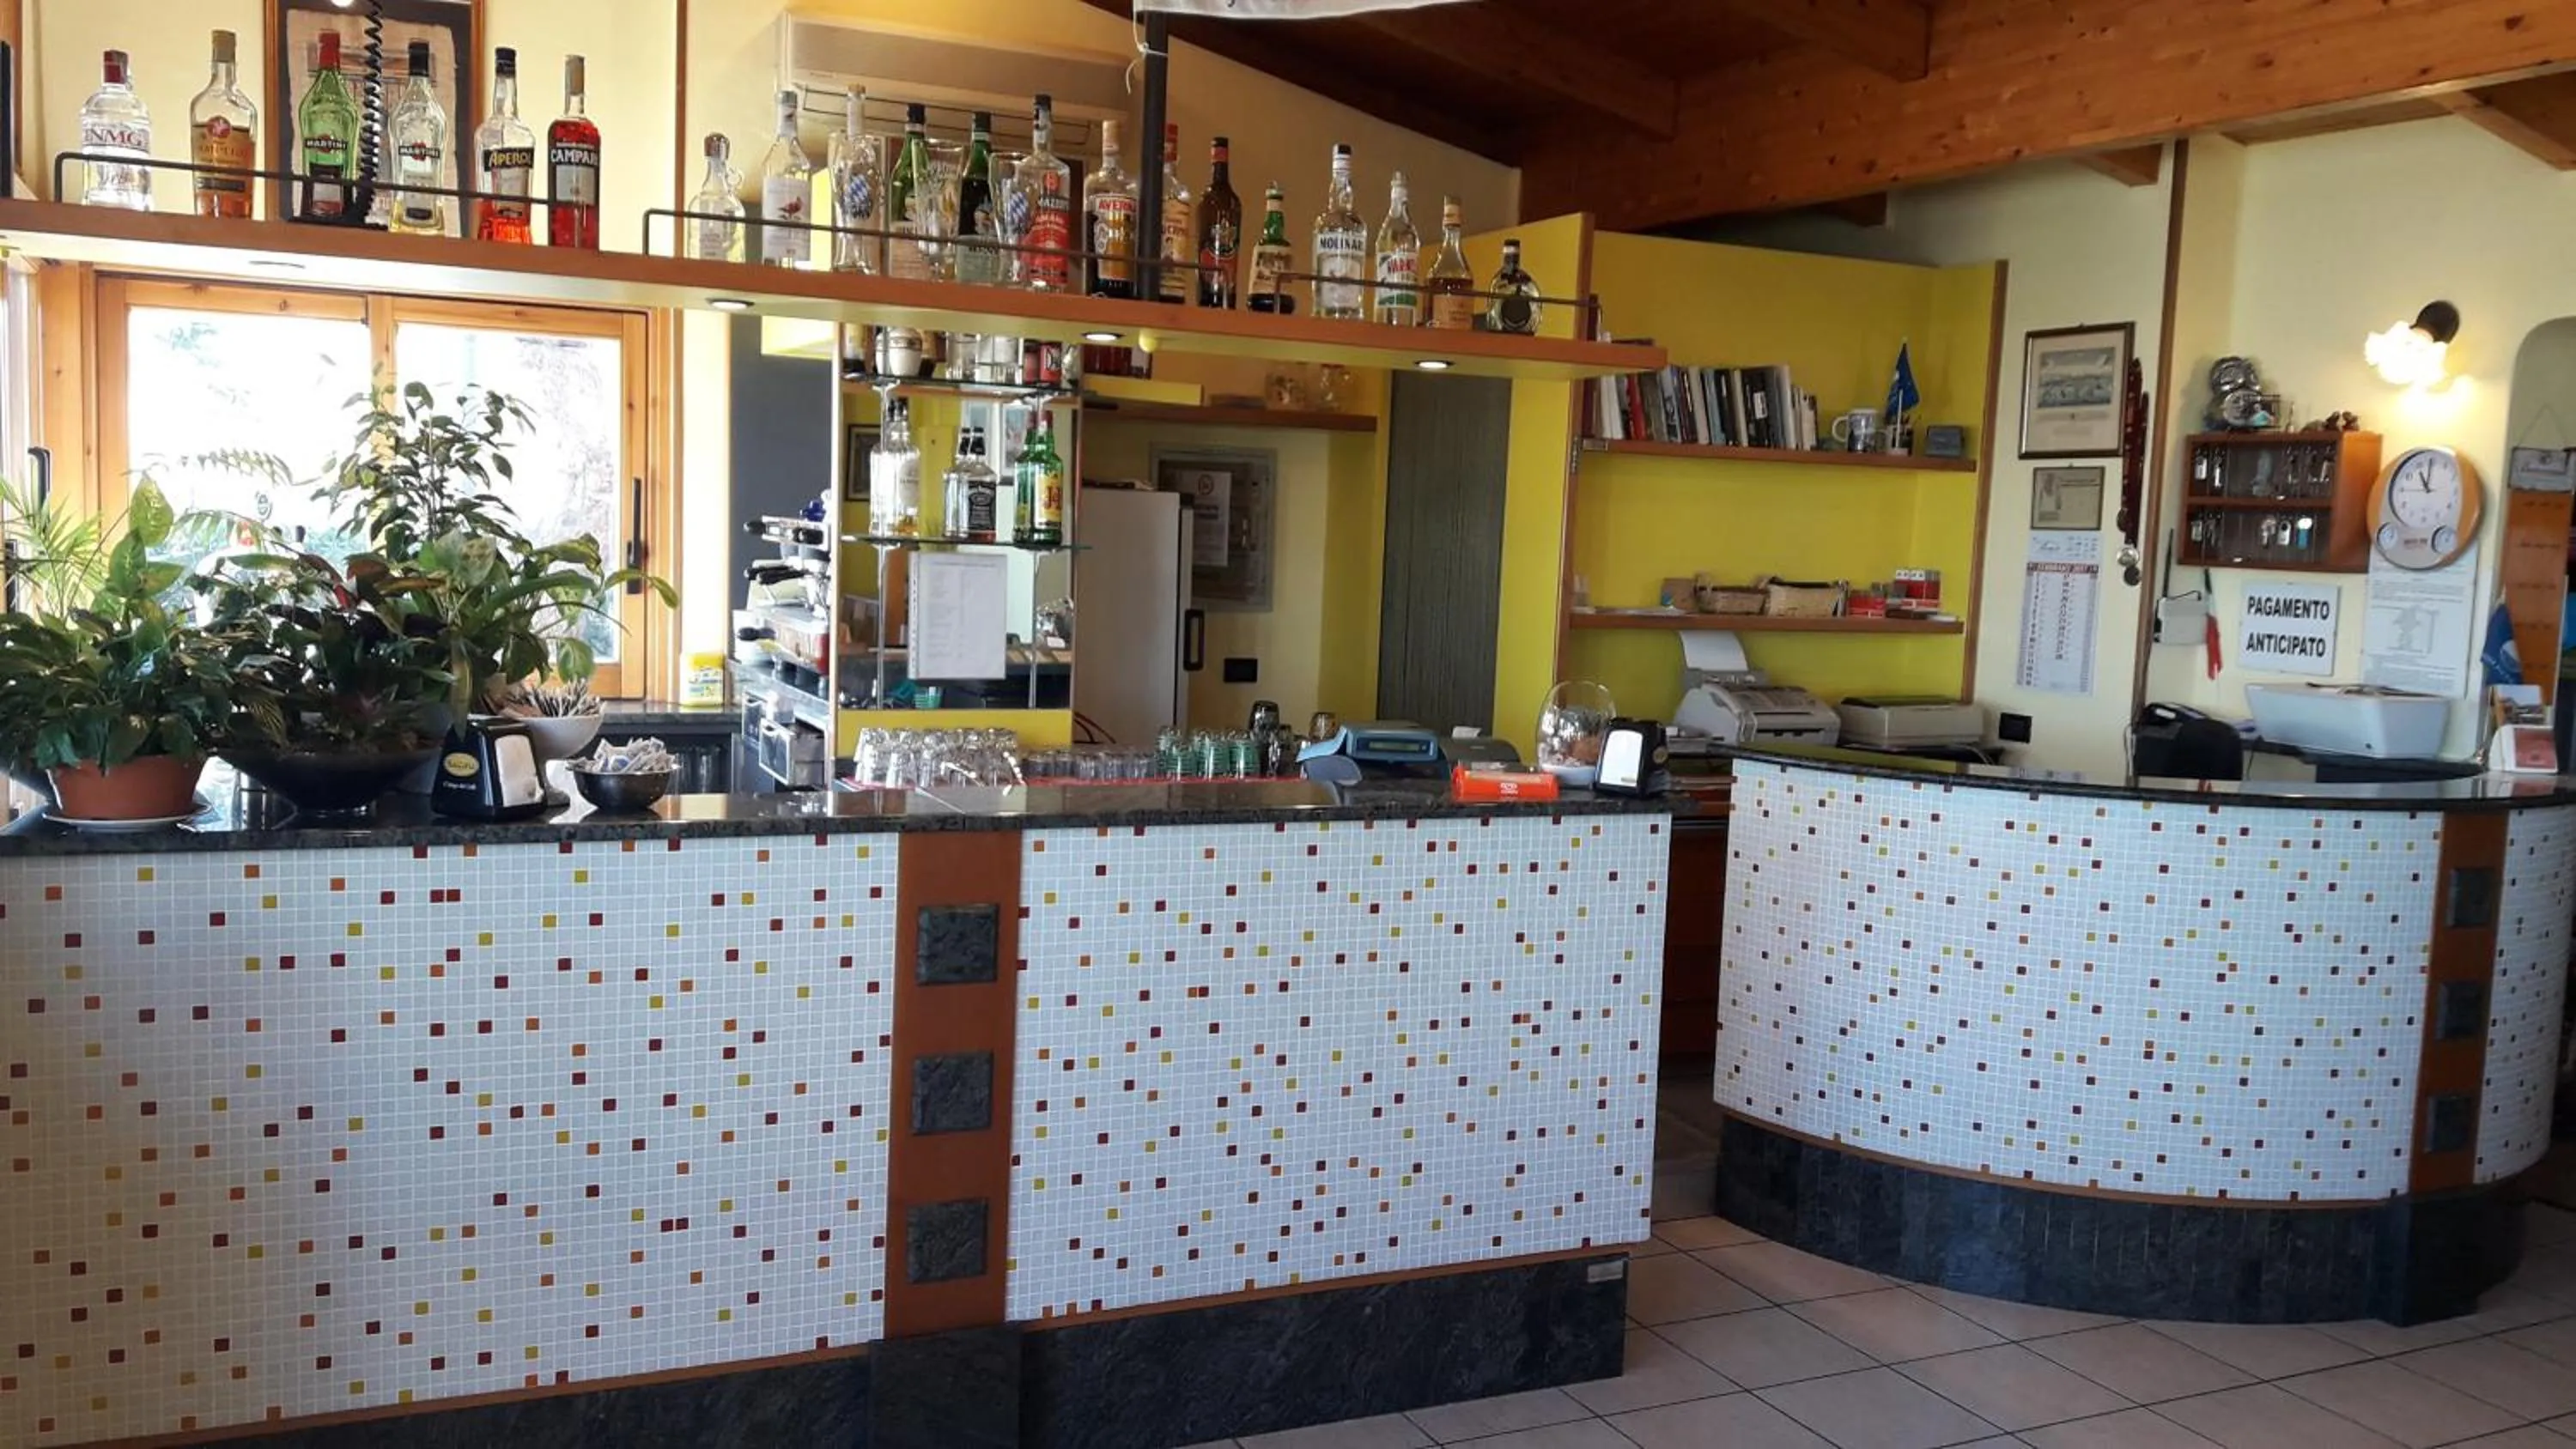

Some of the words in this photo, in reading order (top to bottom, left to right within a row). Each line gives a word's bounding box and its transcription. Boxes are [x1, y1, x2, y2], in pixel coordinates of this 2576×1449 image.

[306, 140, 347, 149] MARTINI
[399, 147, 440, 158] MARTINI
[489, 150, 532, 167] APEROL
[1320, 236, 1364, 252] MOLINAR
[2247, 596, 2330, 621] PAGAMENTO
[2246, 632, 2325, 658] ANTICIPATO
